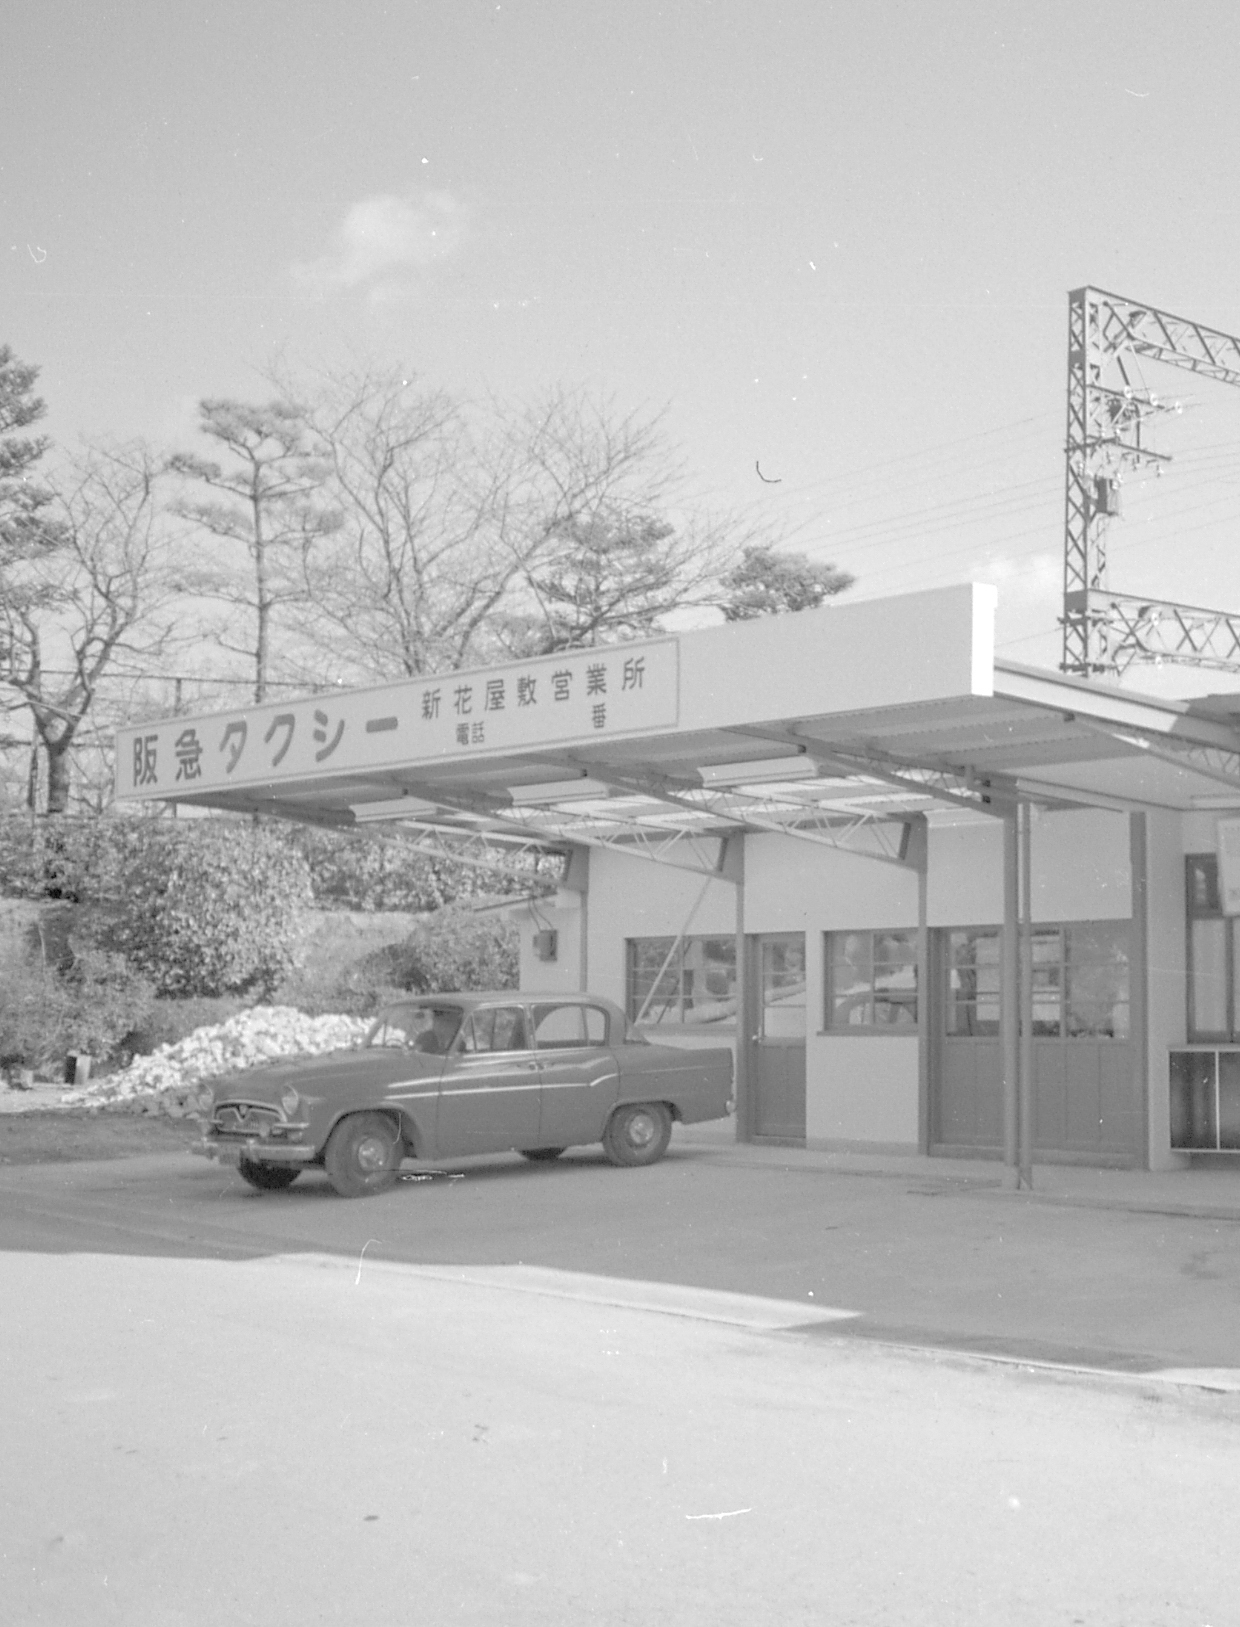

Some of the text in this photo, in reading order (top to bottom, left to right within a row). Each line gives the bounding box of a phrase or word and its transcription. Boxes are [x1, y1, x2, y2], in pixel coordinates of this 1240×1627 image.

[421, 656, 646, 720] 新花屋敷営業所
[132, 708, 399, 787] 阪急タクシー
[455, 702, 608, 746] 電話 番
